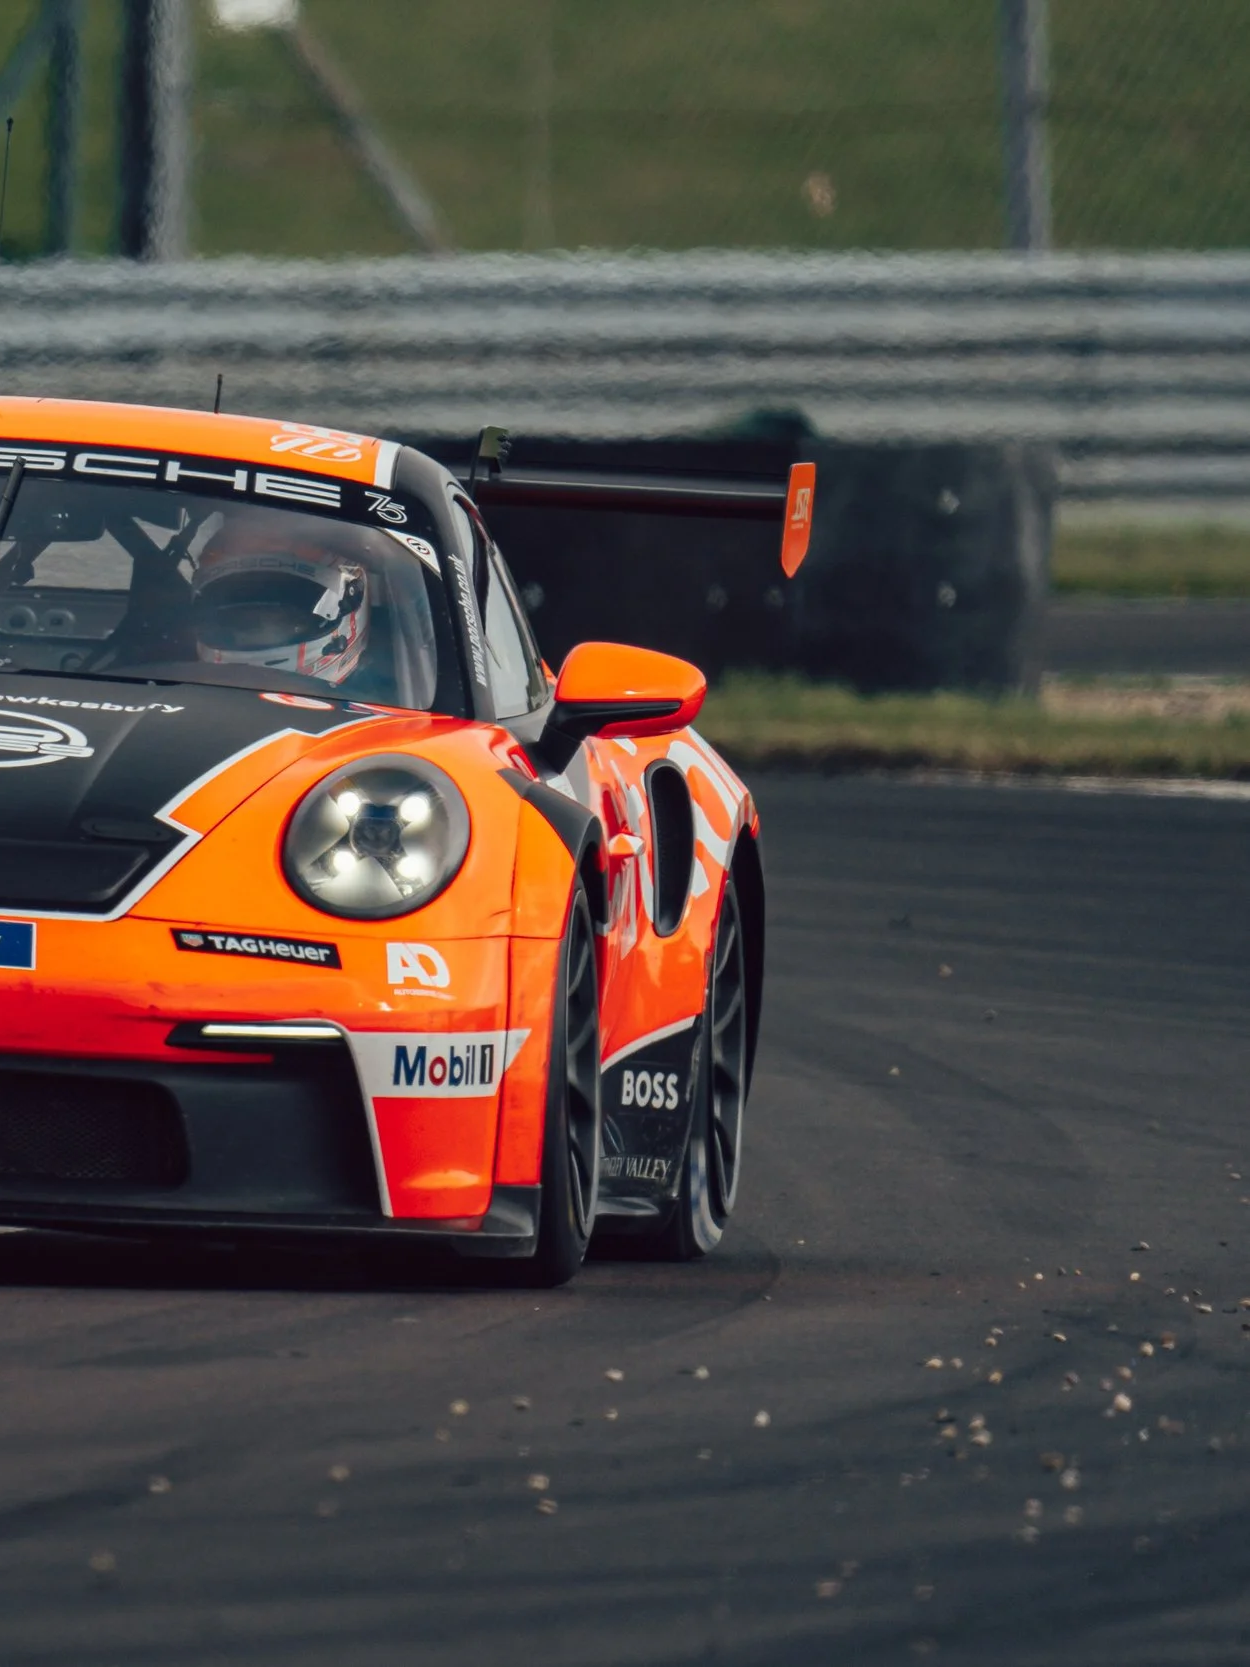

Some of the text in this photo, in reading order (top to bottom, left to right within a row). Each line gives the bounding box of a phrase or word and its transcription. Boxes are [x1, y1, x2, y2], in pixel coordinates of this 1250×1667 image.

[364, 491, 408, 524] 75
[392, 1044, 477, 1087] Mobil
[621, 1070, 679, 1111] BOSS
[625, 1156, 672, 1180] VALLEY
